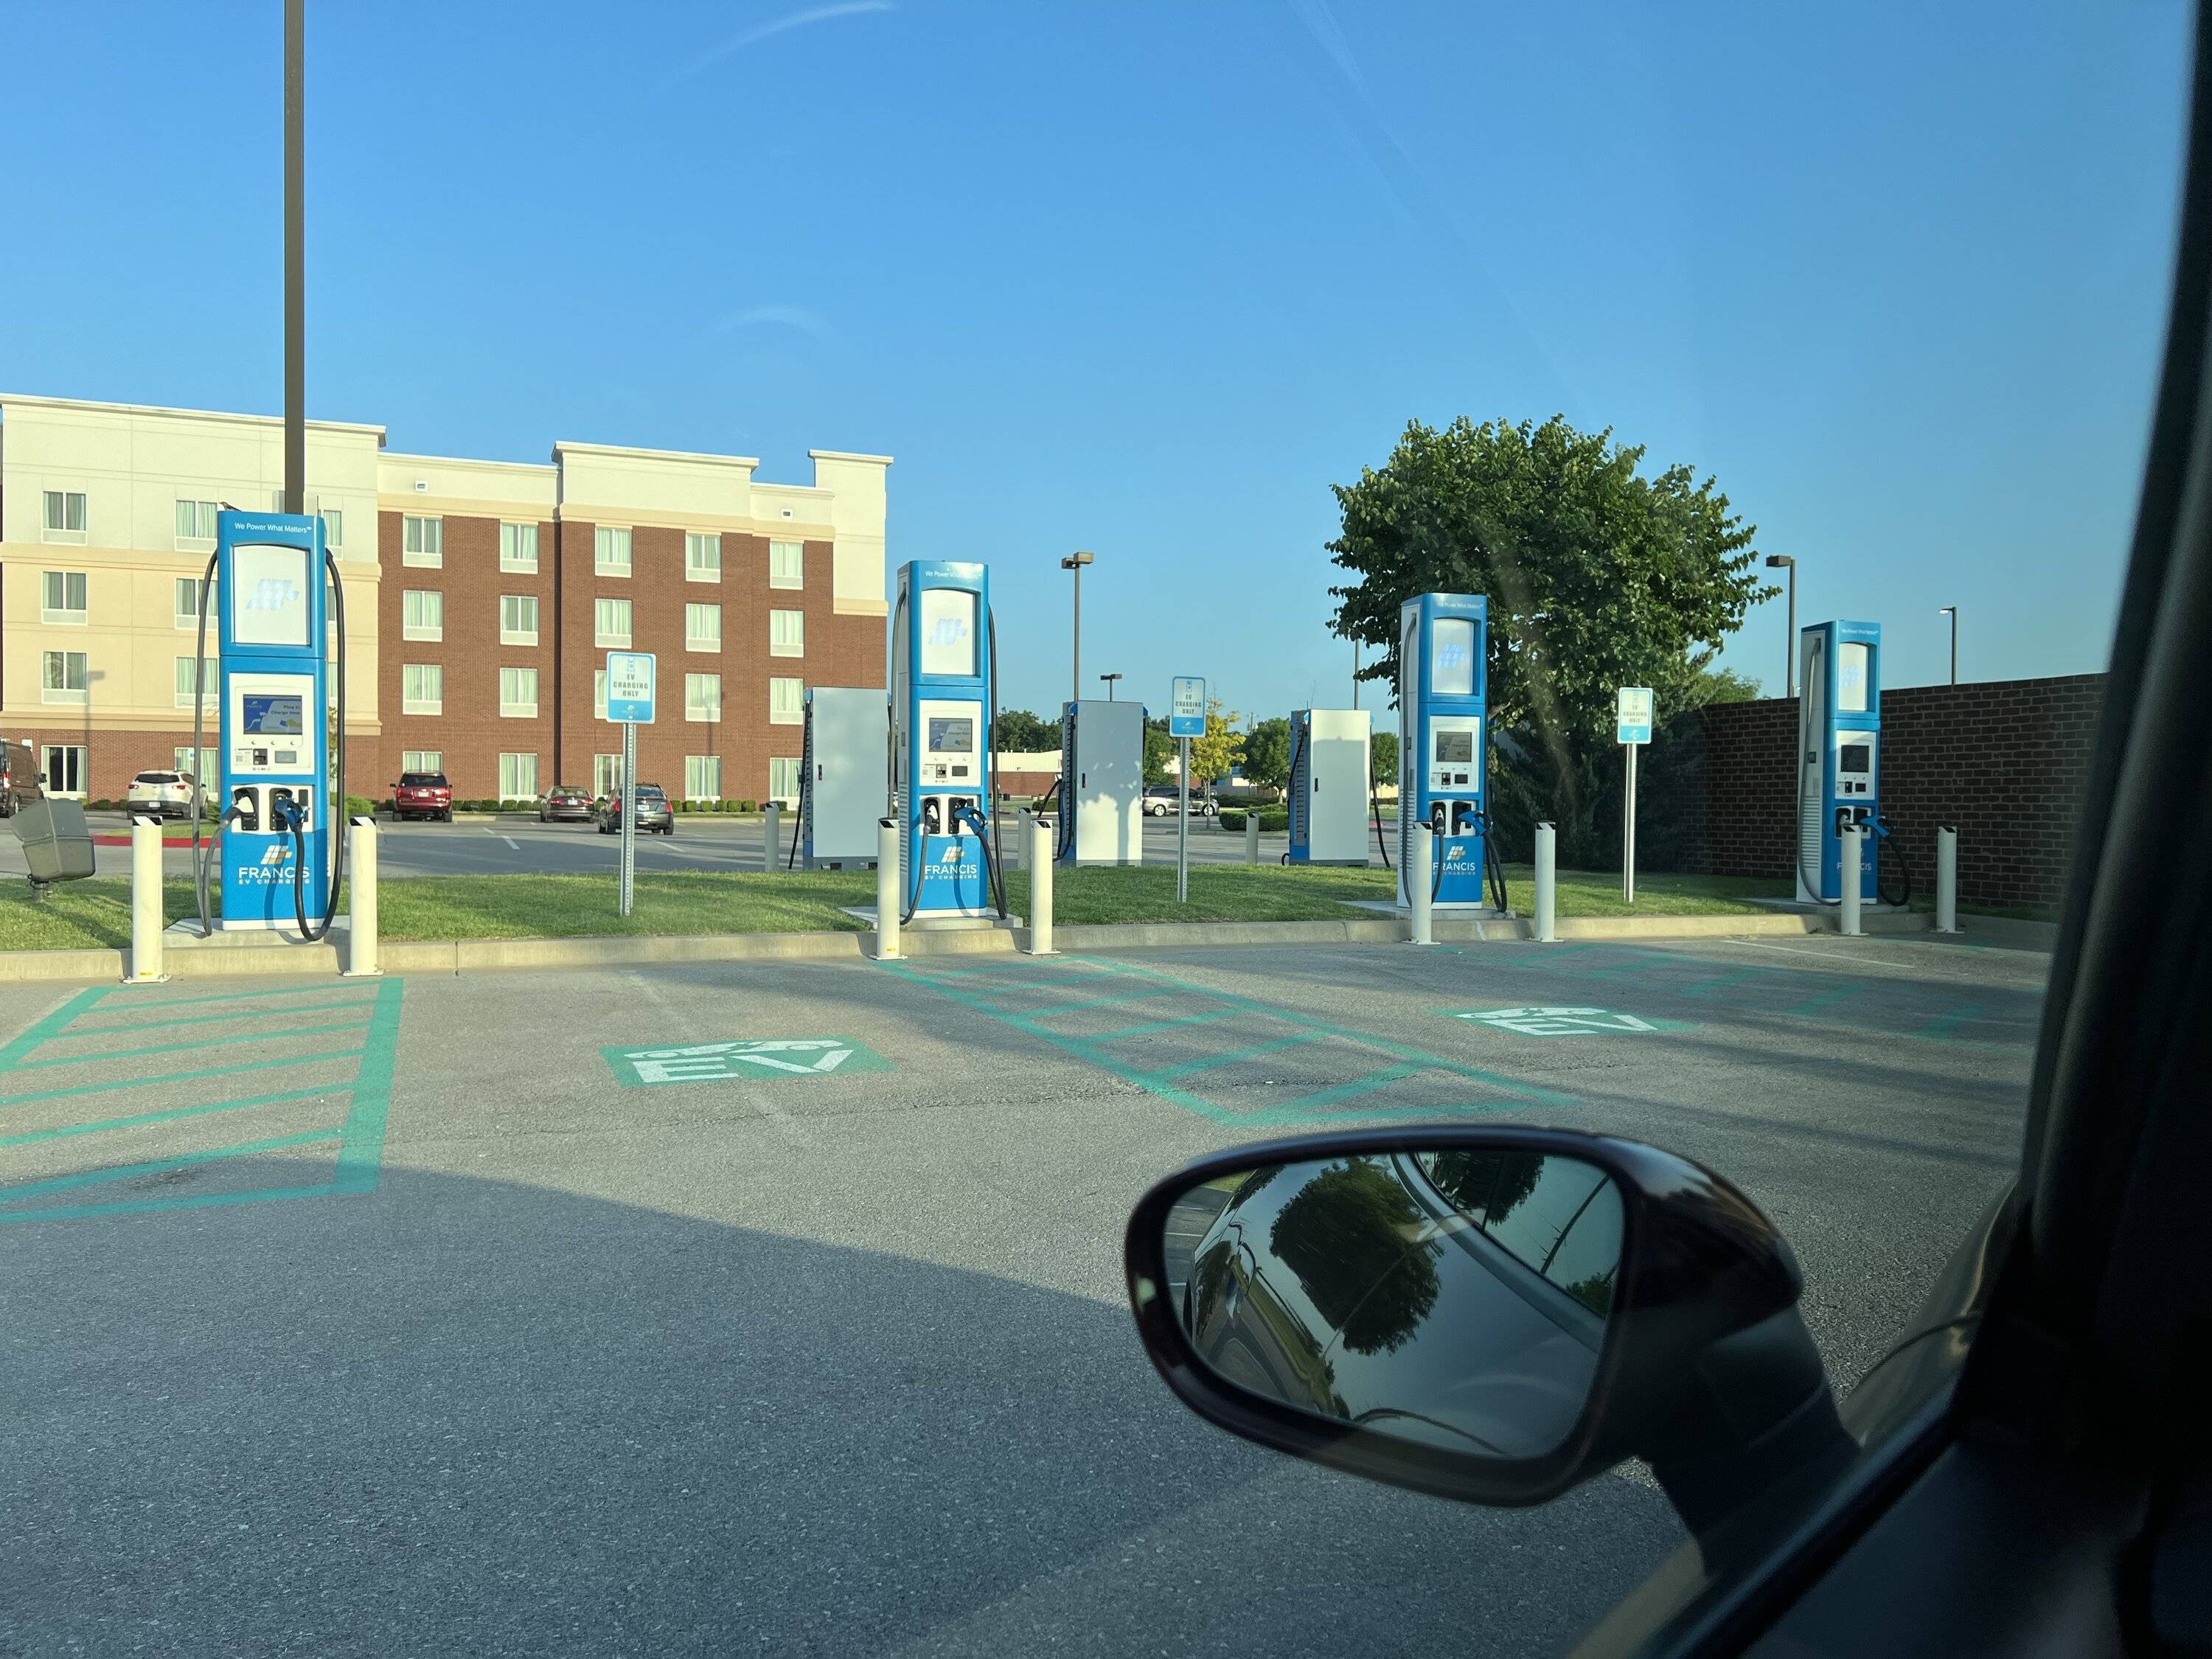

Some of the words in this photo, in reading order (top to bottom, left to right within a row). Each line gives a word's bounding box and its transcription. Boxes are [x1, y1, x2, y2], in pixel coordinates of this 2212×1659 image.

[268, 524, 284, 532] What
[613, 681, 649, 689] CHARGING
[622, 689, 639, 698] ONLY
[925, 864, 978, 874] FRANCIS
[1837, 862, 1872, 871] FCIS
[238, 866, 310, 879] FRANCS
[1480, 1014, 1659, 1036] EV
[632, 1048, 855, 1083] EV
